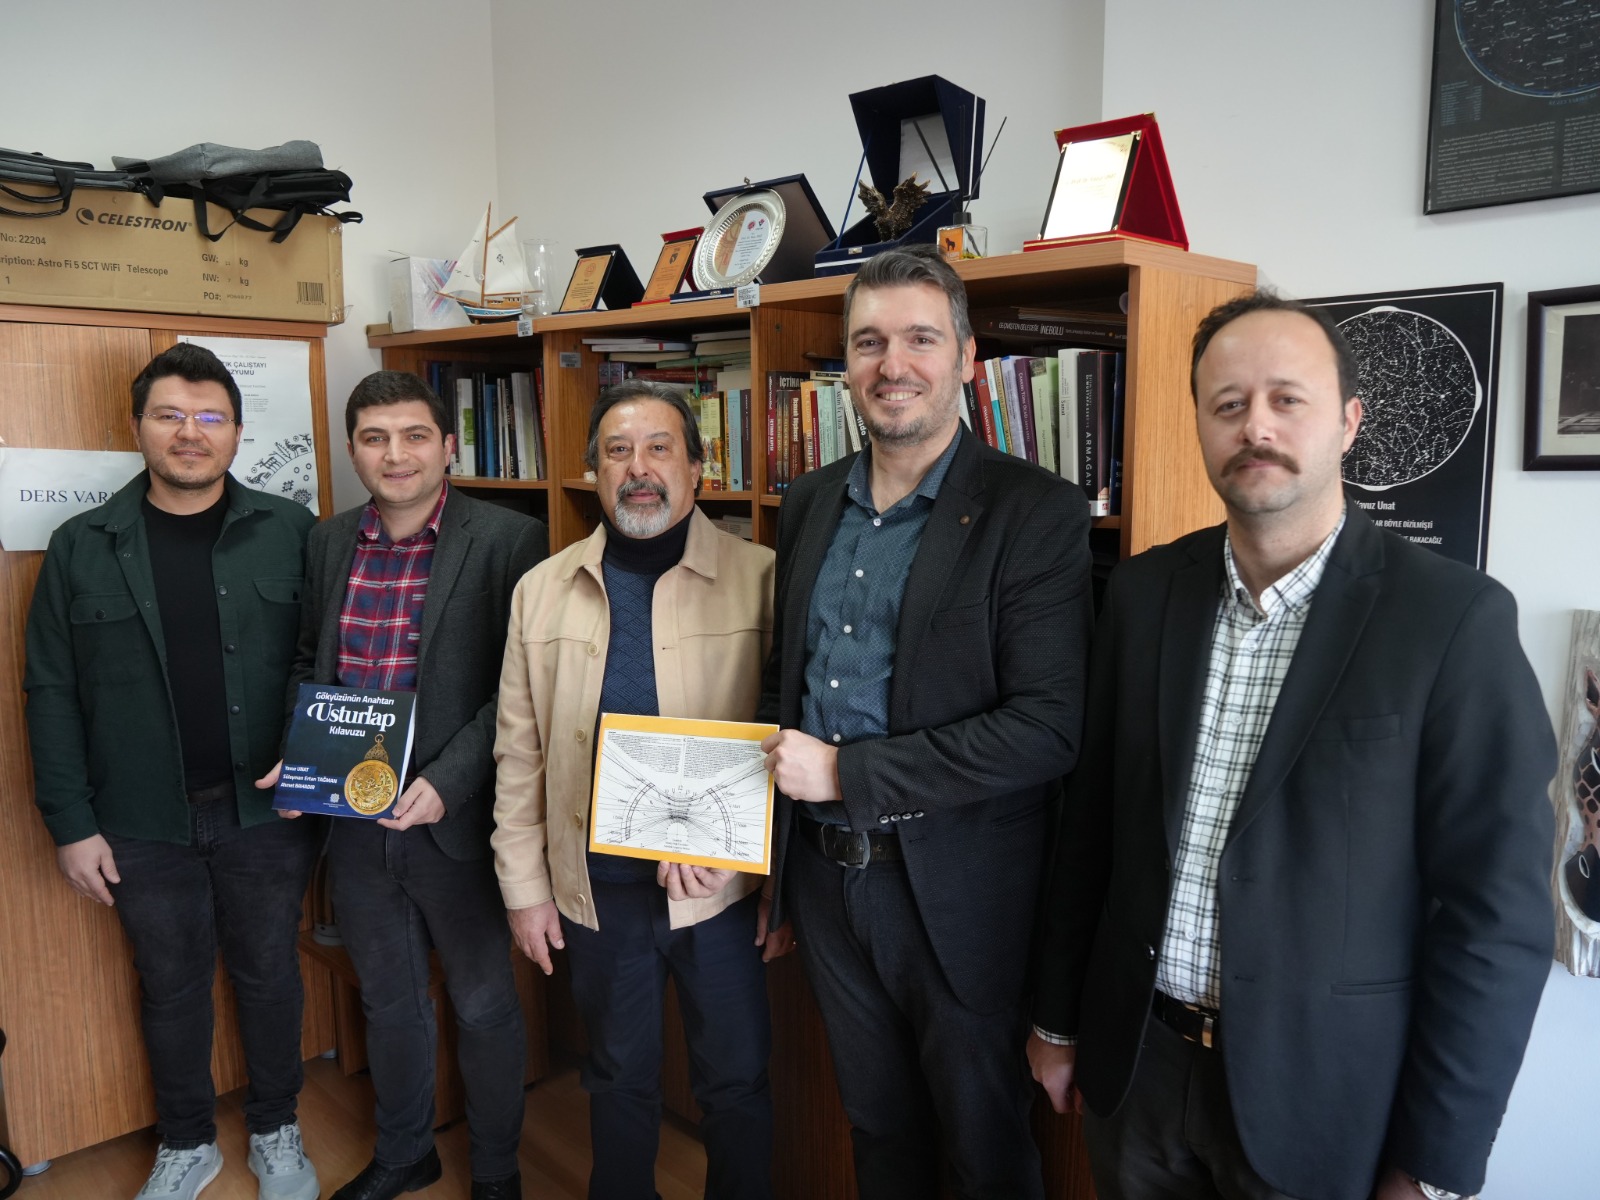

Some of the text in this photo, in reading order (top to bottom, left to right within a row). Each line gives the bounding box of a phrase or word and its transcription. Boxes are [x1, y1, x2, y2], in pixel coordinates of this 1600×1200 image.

[98, 212, 187, 232] CELESTRON
[0, 233, 47, 245] No: 22204
[37, 258, 62, 268] Astro
[64, 259, 72, 268] Fi
[73, 260, 80, 269] 5
[81, 261, 99, 271] SCT
[100, 262, 121, 272] WiFi
[127, 264, 169, 276] Telescope
[201, 253, 219, 263] GW:
[239, 257, 249, 267] kg
[5, 276, 11, 285] 1
[202, 272, 220, 283] NW:
[240, 276, 249, 287] kg
[1040, 324, 1064, 336] İNEBOLU
[779, 375, 804, 389] İÇTİHA
[19, 489, 68, 503] DERS
[1377, 500, 1396, 510] Unat
[1384, 518, 1402, 528] BÖYLE
[315, 691, 395, 706] Gökyüzünün Anahtarı
[306, 702, 396, 733] Usturlap
[329, 725, 366, 738] Kılavuzu
